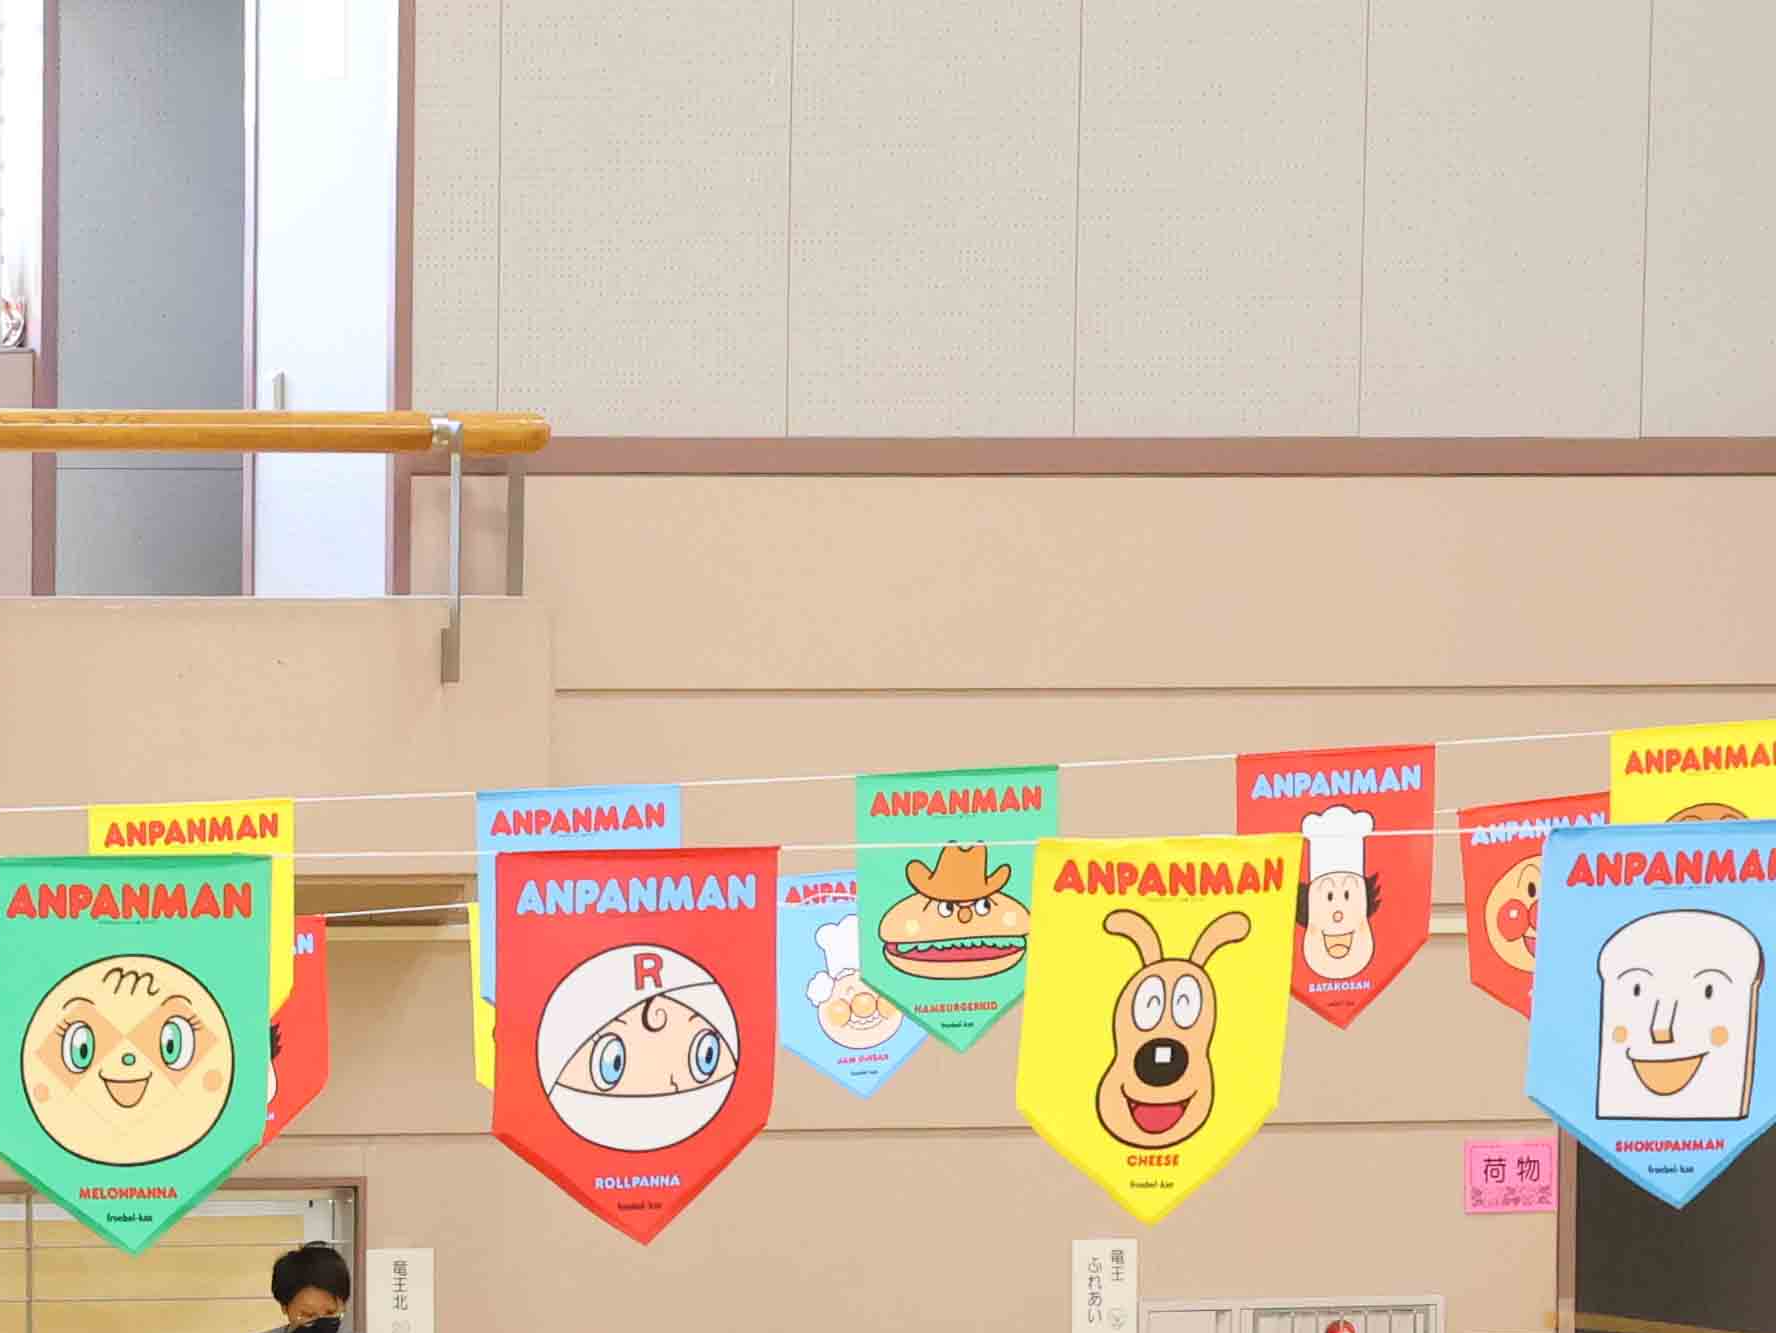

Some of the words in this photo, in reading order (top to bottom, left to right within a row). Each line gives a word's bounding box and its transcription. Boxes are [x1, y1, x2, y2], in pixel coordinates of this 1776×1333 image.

[1251, 765, 1422, 799] ANPANMAN
[870, 786, 1042, 817] ANPANMAN
[104, 813, 279, 847] ANPANMAN
[490, 803, 665, 836] ANPANMAN
[1053, 857, 1284, 898] ANPANMAN
[5, 883, 253, 920] ANPANMAN
[516, 874, 757, 916] ANPANMAN
[633, 952, 664, 990] R
[1126, 1154, 1180, 1168] CHEESE
[1615, 1138, 1725, 1153] SHOKUPANMAN
[594, 1174, 681, 1190] ROLLPANNA
[1483, 1156, 1540, 1184] 荷物
[78, 1186, 178, 1200] MELONPANNA
[1088, 1255, 1103, 1324] ふれあい
